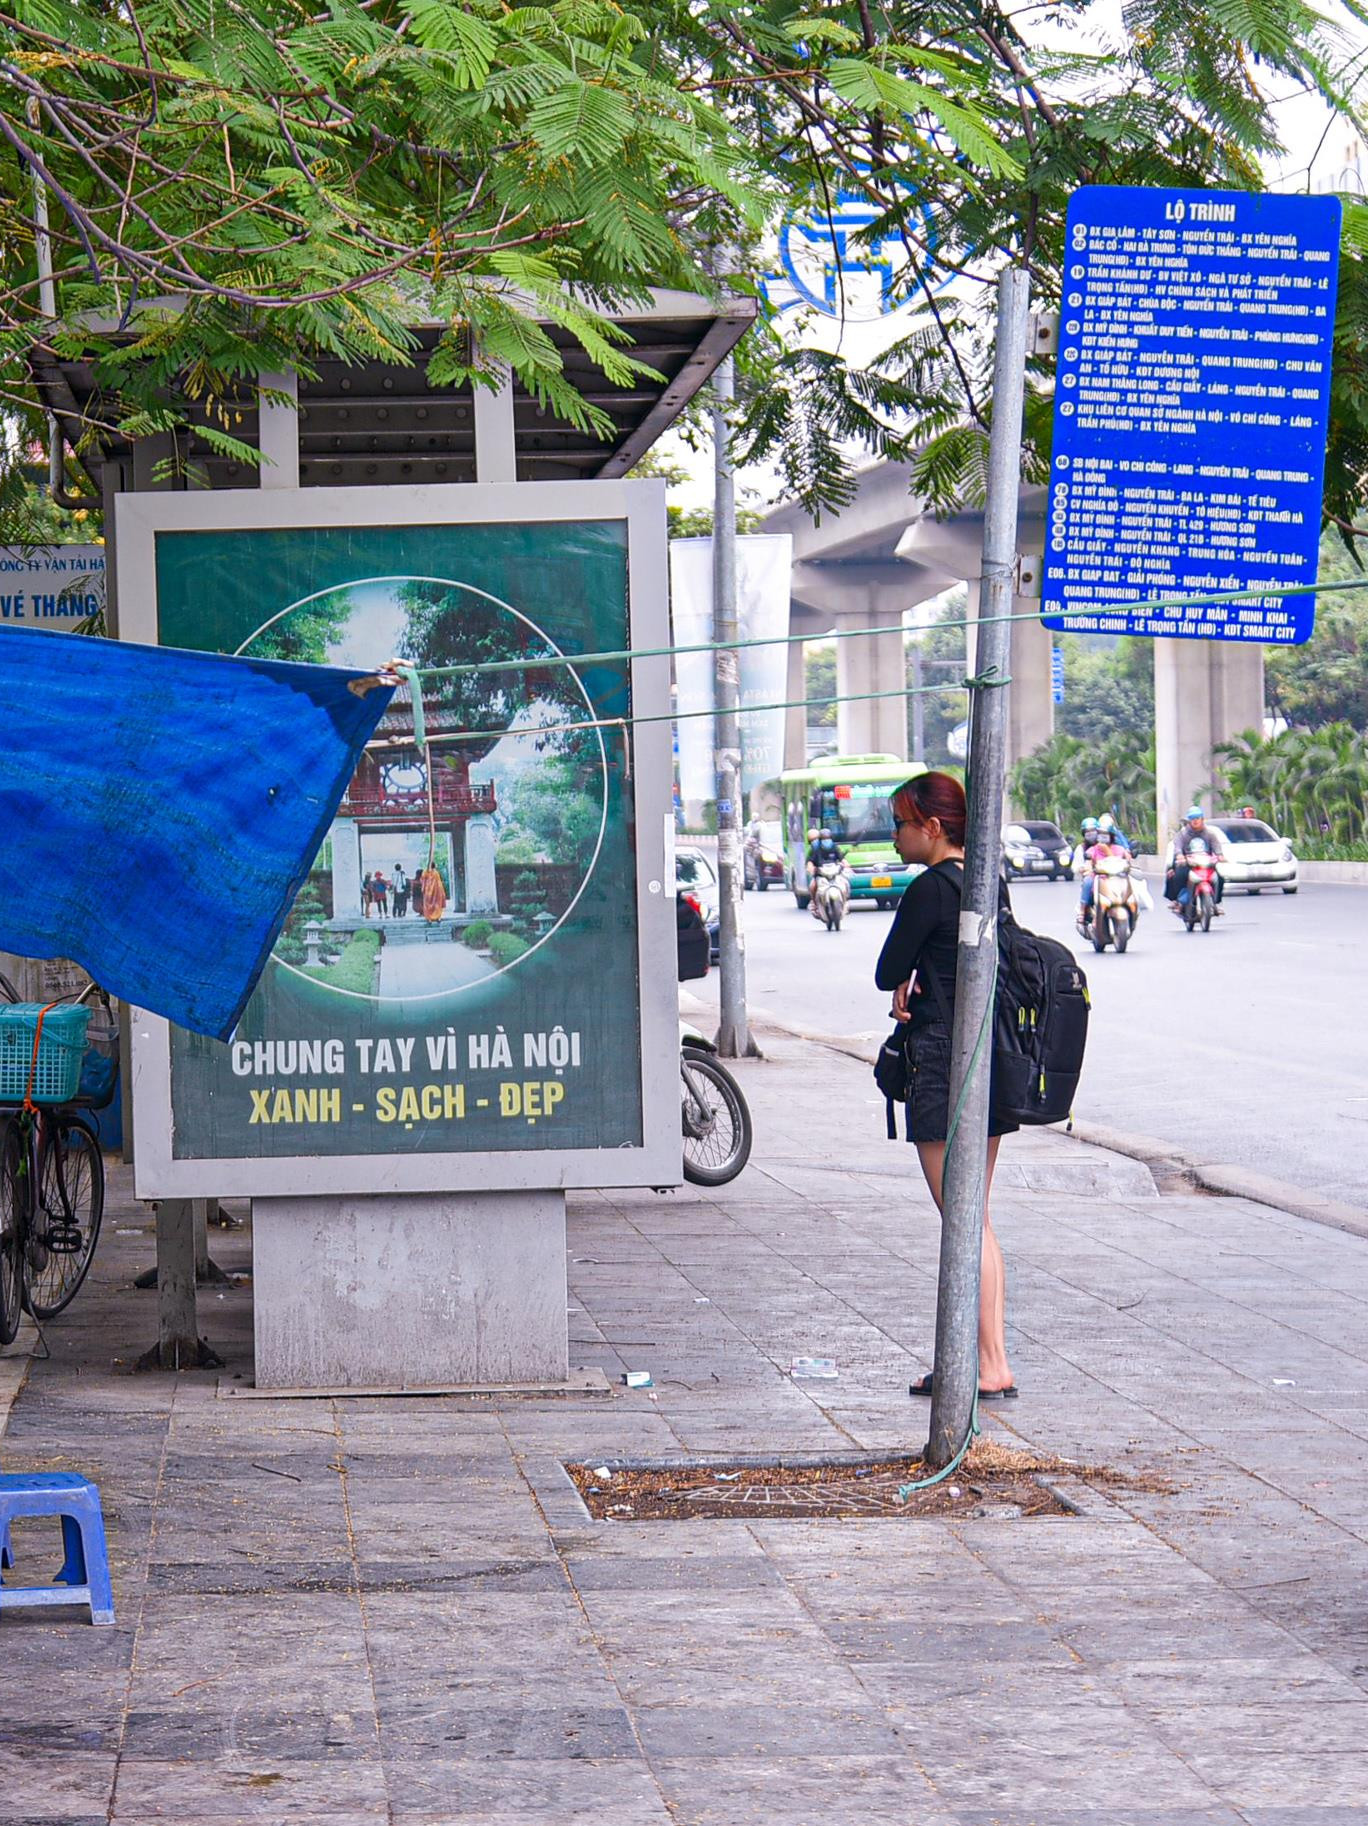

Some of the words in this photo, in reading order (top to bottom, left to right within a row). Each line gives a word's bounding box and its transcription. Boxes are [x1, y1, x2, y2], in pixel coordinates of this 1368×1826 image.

[1164, 198, 1185, 223] LỘ
[1188, 199, 1236, 222] TRÌNH
[1123, 241, 1136, 251] HAI
[1303, 250, 1330, 261] QUANG
[1158, 270, 1169, 281] BV
[1155, 284, 1166, 295] HV
[1084, 309, 1094, 319] LA
[1239, 302, 1266, 313] QUANG
[1314, 306, 1326, 316] BA
[1079, 362, 1092, 373] AN
[1201, 356, 1230, 367] QUANG
[1285, 360, 1303, 371] CHU
[1091, 377, 1110, 388] NAM
[1137, 379, 1159, 390] LONG
[1291, 388, 1319, 399] QUANG
[1077, 404, 1094, 414] KHU
[1127, 407, 1151, 418] QUAN
[1072, 457, 1083, 468] SB
[1099, 459, 1112, 470] BAI
[1255, 469, 1282, 481] QUANG
[1283, 471, 1308, 482] TRUNG
[1070, 499, 1080, 509] CV
[1180, 492, 1192, 502] BA
[1193, 493, 1203, 503] LA
[1210, 494, 1226, 504] KIM
[1178, 519, 1186, 529] TL
[1188, 519, 1203, 530] 429
[1177, 533, 1187, 543] QL
[1188, 534, 1204, 544] 21B
[1150, 545, 1179, 557] KHANG
[1188, 548, 1216, 559] TRUNG
[1047, 567, 1065, 578] E06.
[0, 588, 24, 618] VÉ
[1063, 585, 1093, 597] QUANG
[1263, 596, 1282, 608] CITY
[1044, 600, 1061, 611] E04
[1163, 606, 1182, 618] CHU
[1185, 607, 1203, 619] HUY
[1238, 610, 1262, 622] MINH
[1266, 611, 1287, 623] KHAI
[1098, 618, 1126, 630] CHINH
[1242, 625, 1273, 637] SMART
[1275, 627, 1295, 638] CITY
[231, 1038, 345, 1076] CHUNG
[355, 1036, 417, 1074] TAY
[427, 1026, 457, 1070] VÌ
[468, 1025, 513, 1069] HÀ
[524, 1025, 582, 1075] NỘI
[248, 1088, 341, 1124] XANH
[375, 1083, 466, 1130] SẠCH
[499, 1081, 566, 1125] ĐẸP
